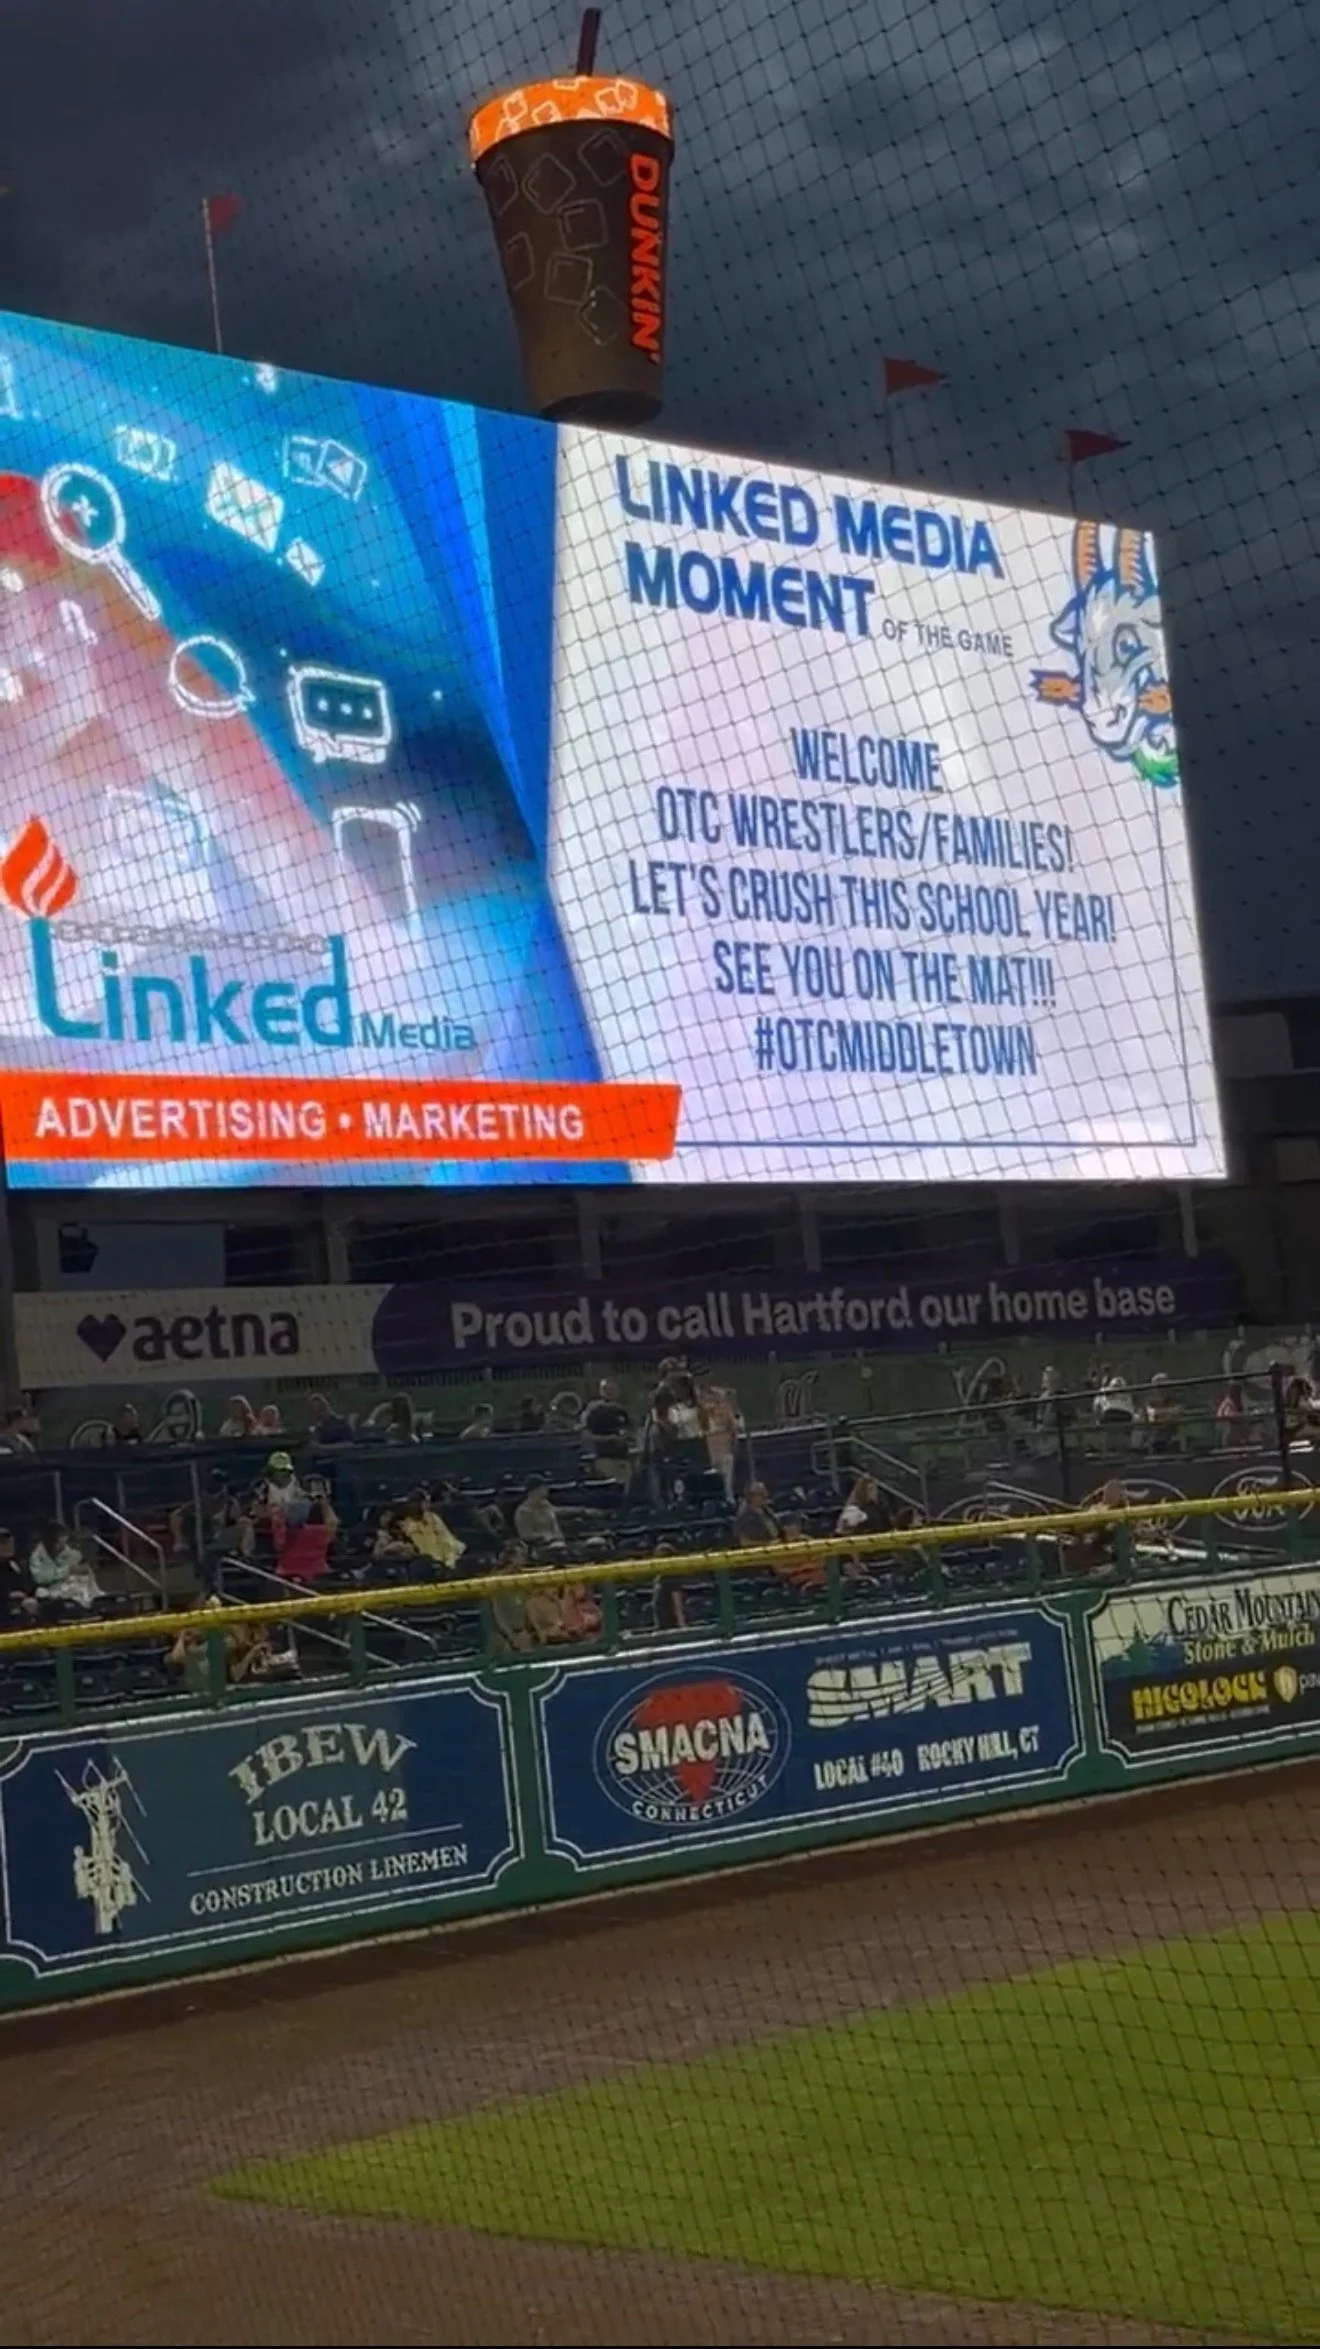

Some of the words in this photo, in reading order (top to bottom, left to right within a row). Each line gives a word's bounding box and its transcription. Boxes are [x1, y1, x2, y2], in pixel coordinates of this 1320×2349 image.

[630, 153, 661, 365] DUNKIN'
[616, 455, 820, 546] LINKED
[834, 493, 1004, 578] MEDIA
[625, 541, 876, 635] MOMENT
[882, 619, 910, 642] OF
[914, 624, 956, 650] THE
[958, 631, 1014, 657] GAME
[791, 727, 944, 793] WELCOME
[656, 786, 721, 843] OTC
[729, 794, 1075, 872] WRESTLERS/FAMILIES!
[629, 859, 721, 919] LET'S
[729, 866, 835, 928] CRUSH
[841, 877, 912, 931] THIS
[918, 880, 1030, 938] SCHOOL
[1033, 890, 1117, 943] YEAR!
[29, 916, 352, 1048] Linked
[360, 1016, 476, 1052] Media
[713, 940, 776, 996] SEE
[782, 945, 846, 999] YOU
[855, 949, 896, 1001] ON
[902, 951, 959, 1005] THE
[967, 955, 1057, 1008] MAT!!!
[755, 1016, 1038, 1076] #OTCMIDDLETOWN
[35, 1097, 327, 1140] ADVERTISING
[364, 1101, 584, 1141] MARKETING
[132, 1305, 302, 1361] aetna
[451, 1297, 593, 1350] Proud
[601, 1300, 647, 1343] to
[657, 1291, 735, 1341] call
[742, 1284, 913, 1337] Hartford
[919, 1295, 983, 1327] our
[988, 1282, 1090, 1324] home
[1094, 1277, 1177, 1318] base
[1167, 1597, 1233, 1636] CEDAR
[1184, 1638, 1237, 1665] Stone
[1259, 1622, 1316, 1652] Mulch
[806, 1641, 1033, 1729] SMART
[228, 1723, 417, 1804] IBEW
[613, 1713, 770, 1776] SMACNA
[813, 1754, 870, 1791] LOCAL
[870, 1747, 905, 1779] #40
[917, 1735, 975, 1773] ROCKY
[1018, 1725, 1040, 1753] CT
[253, 1795, 365, 1846] LOCAL
[370, 1787, 409, 1824] 42
[632, 1775, 770, 1822] CONNECTICUT
[189, 1865, 364, 1916] CONSTRUCTION
[370, 1843, 470, 1880] LINEMEN
